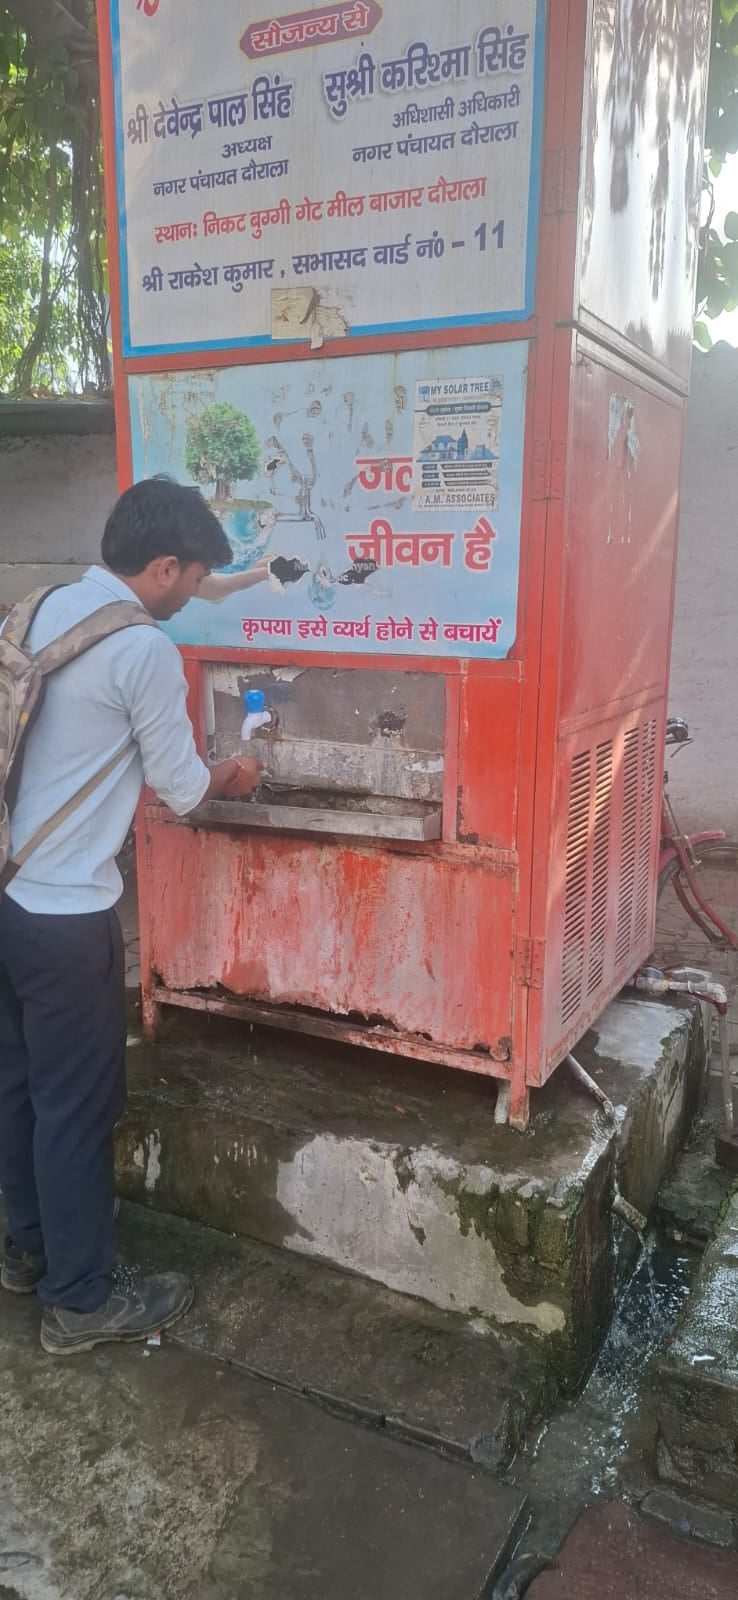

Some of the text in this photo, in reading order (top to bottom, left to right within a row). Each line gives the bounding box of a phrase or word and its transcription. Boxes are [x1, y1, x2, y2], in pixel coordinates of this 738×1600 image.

[252, 5, 369, 50] सौजन्य से
[325, 25, 529, 116] सुश्री करिश्मा सिंह
[127, 75, 292, 144] श्री देवेन्द्र पाल सिंह
[392, 84, 520, 128] अधिशासी अधिकारी
[222, 136, 272, 158] अध्यक्ष
[352, 121, 519, 162] नगर पंचायत दौराला
[153, 159, 289, 196] नगर पंचायत दौराला
[203, 211, 247, 237] निकट
[250, 199, 291, 239] बुग्गी
[296, 197, 323, 221] गेट
[327, 190, 365, 217] मील
[369, 187, 424, 213] बाजार
[428, 176, 487, 203] दौराला
[143, 267, 163, 292] श्री
[168, 262, 218, 290] राकेश
[292, 248, 368, 275] सभासद
[373, 234, 411, 264] वार्ड
[474, 220, 504, 250] 11
[431, 382, 489, 395] MY SOLAR TREE
[425, 493, 495, 504] A.M. ASSOCIATES
[345, 517, 496, 570] जीवन है
[241, 615, 501, 643] कृपया इसे व्यर्थ होने से बचायें
